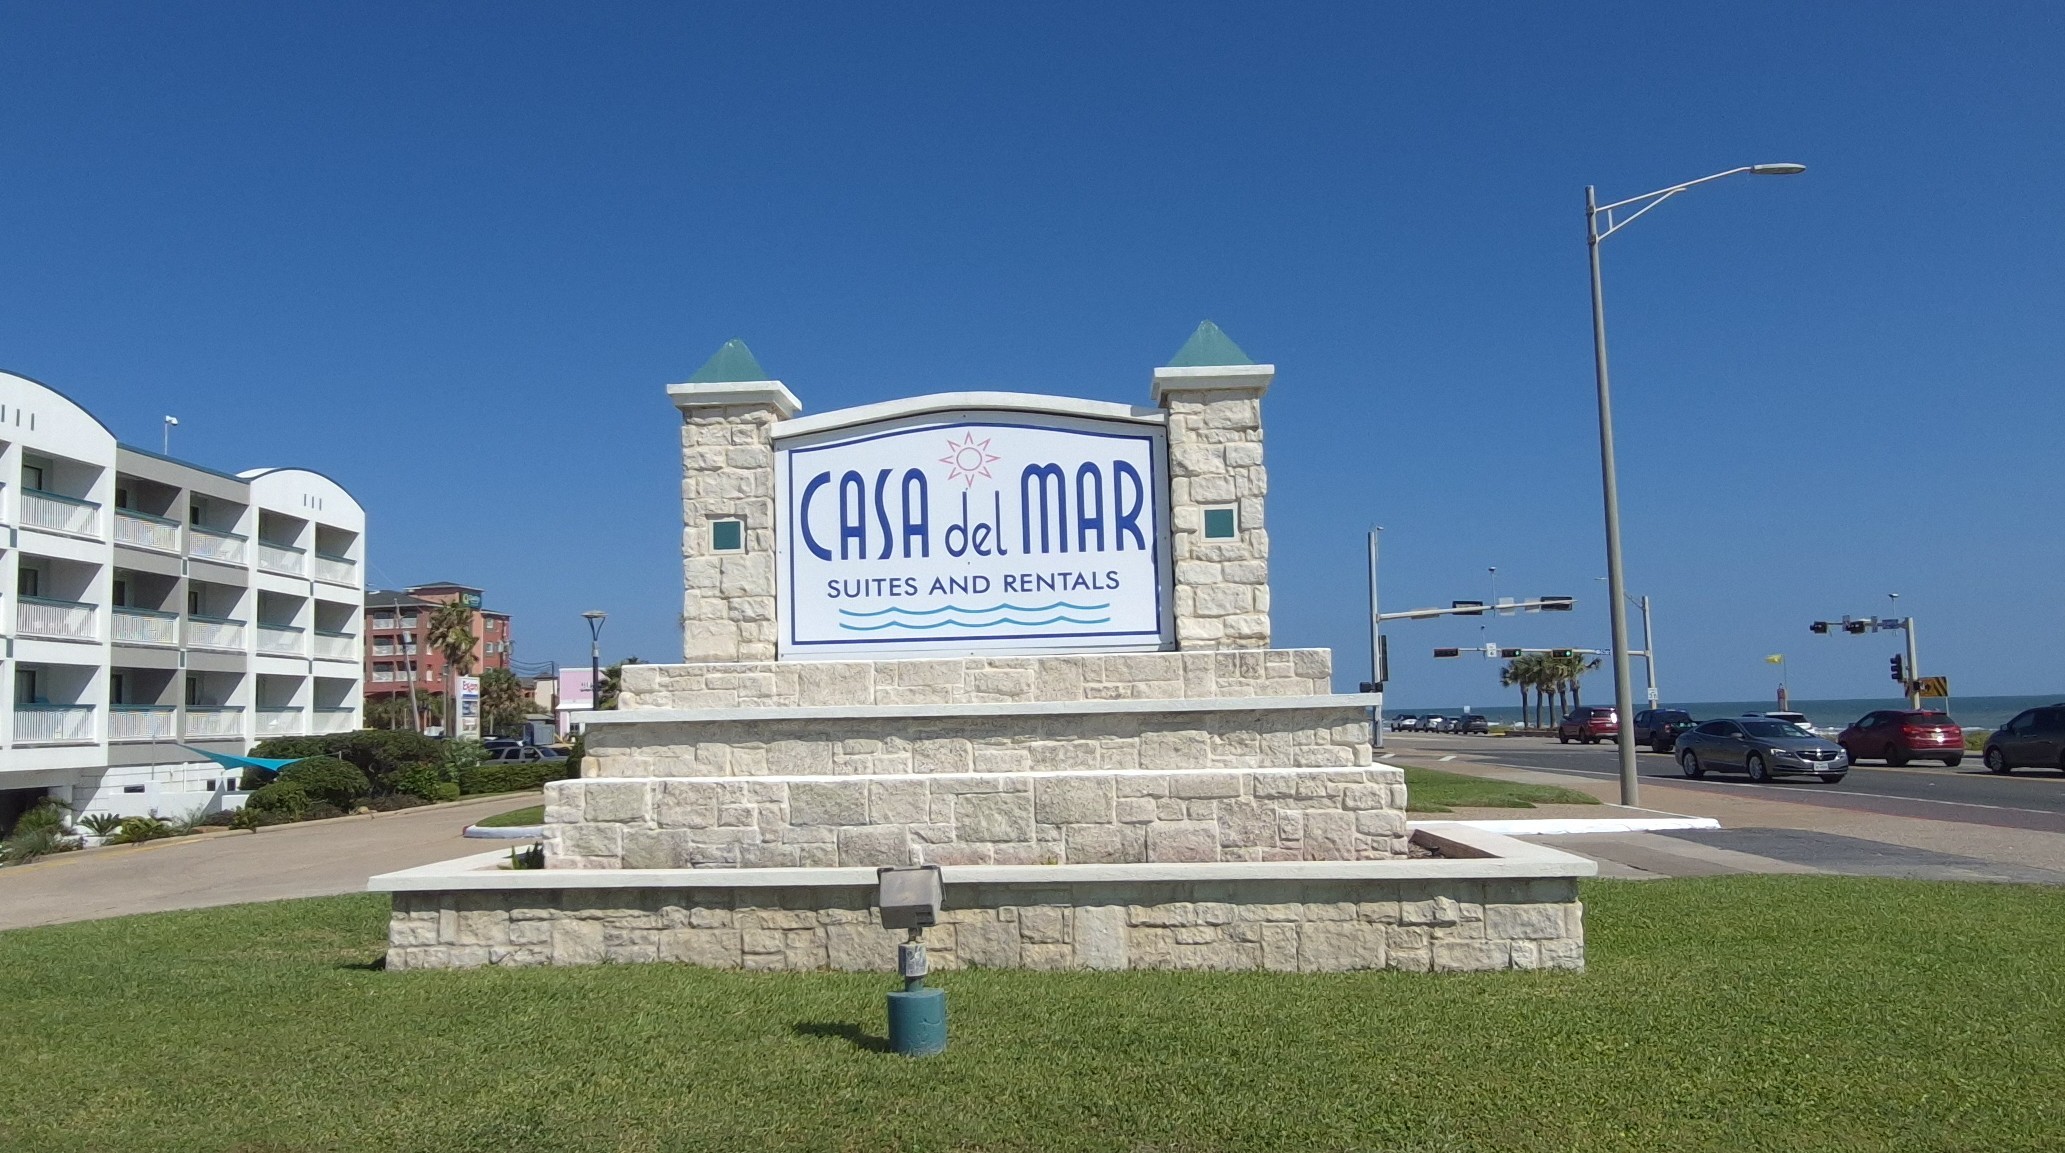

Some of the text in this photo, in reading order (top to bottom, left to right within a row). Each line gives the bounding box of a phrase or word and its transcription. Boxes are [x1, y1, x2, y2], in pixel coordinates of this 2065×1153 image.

[800, 459, 1146, 562] CASA del MAR
[827, 570, 1120, 599] SUITES AND RENTALS
